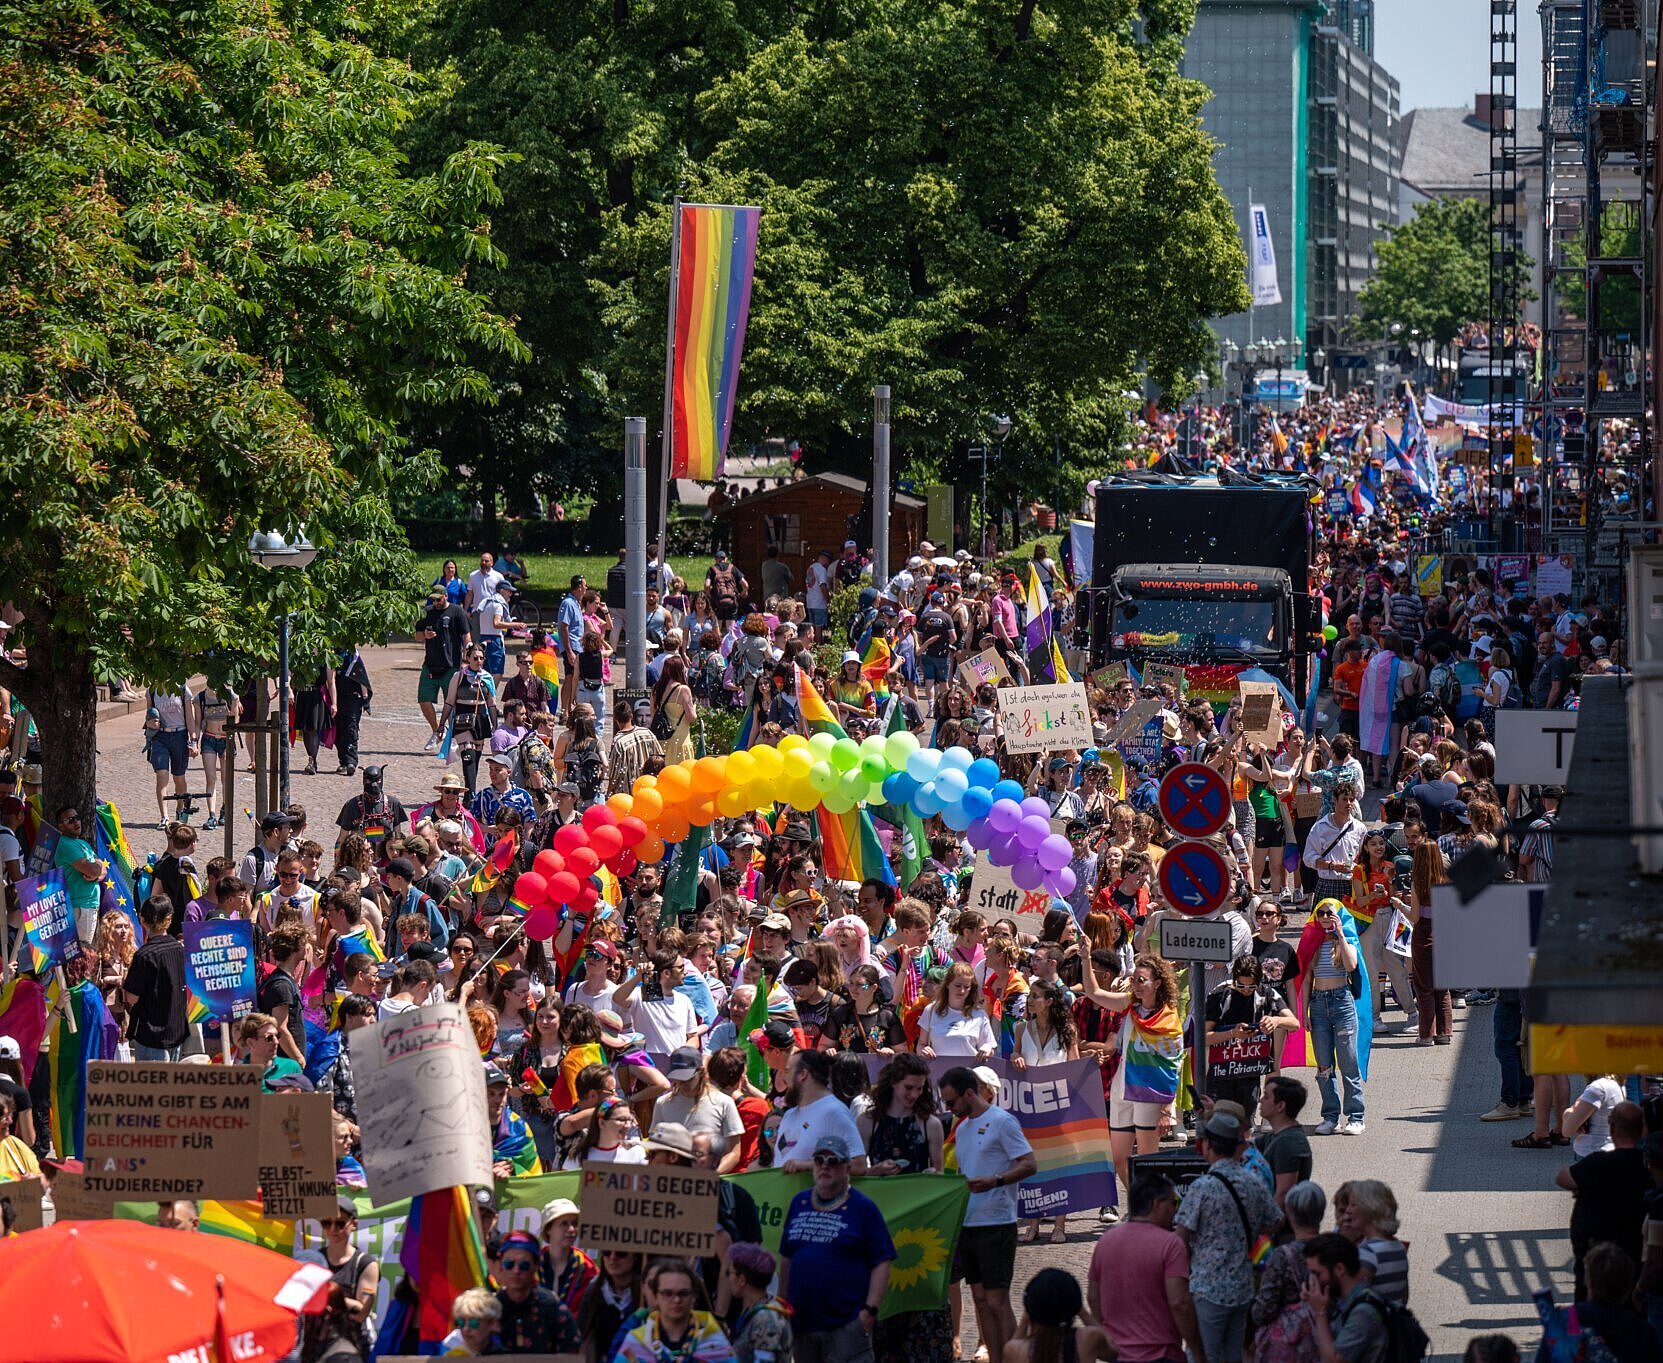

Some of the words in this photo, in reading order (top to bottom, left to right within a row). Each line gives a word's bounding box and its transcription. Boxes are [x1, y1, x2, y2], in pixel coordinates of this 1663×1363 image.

[1140, 580, 1258, 591] www.zwo-gmbh.de
[1020, 691, 1040, 703] doch
[1022, 708, 1066, 738] fickst
[26, 902, 39, 918] MY
[39, 894, 58, 912] LOVE
[58, 890, 66, 903] IS
[978, 886, 1019, 912] statt
[32, 912, 53, 930] BLIND
[53, 903, 68, 923] FOR
[39, 918, 70, 941] GENDER!
[200, 934, 235, 950] QUEERE
[1166, 932, 1226, 949] Ladezone
[190, 949, 226, 966] RECHTE
[226, 946, 248, 960] SIND
[194, 960, 248, 980] MENSCHEN-
[205, 974, 242, 992] RECHTE!
[1222, 1049, 1230, 1060] to
[1232, 1045, 1262, 1059] FUCK
[89, 1068, 168, 1084] @HOLGER
[1213, 1064, 1226, 1077] the
[1228, 1060, 1267, 1076] Patriarchy
[87, 1093, 154, 1108] WARUM
[158, 1094, 196, 1108] GIBT
[200, 1096, 217, 1109] ES
[222, 1096, 250, 1110] AM
[87, 1113, 112, 1127] KIT
[116, 1114, 162, 1128] KEINE
[166, 1114, 250, 1130] CHANCEN-
[86, 1134, 178, 1148] GLEICHHEIT
[182, 1132, 213, 1149] FÜR
[259, 1166, 312, 1181] SELBST-
[84, 1177, 204, 1193] STUDIERENDE?
[262, 1181, 337, 1198] BESTIMMUNG
[584, 1170, 651, 1192] PFADIS
[656, 1176, 718, 1197] GEGEN
[1018, 1187, 1042, 1200] ÜNE
[1024, 1190, 1069, 1209] JUGEND
[263, 1198, 306, 1215] JETZT!
[614, 1198, 684, 1219] QUEER-
[580, 1224, 714, 1250] FEINDLICHKEIT
